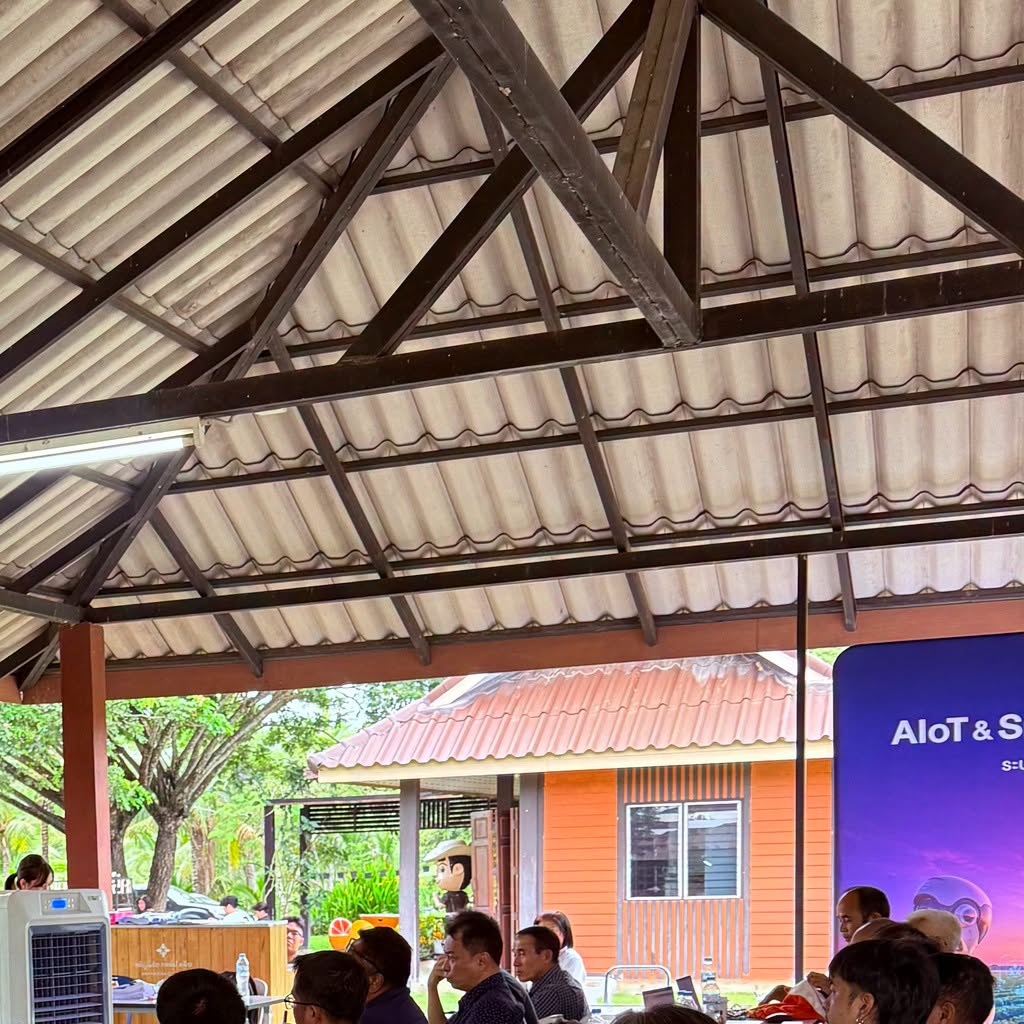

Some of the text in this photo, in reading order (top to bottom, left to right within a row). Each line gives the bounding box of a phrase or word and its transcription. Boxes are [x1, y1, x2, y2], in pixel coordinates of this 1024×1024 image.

[891, 713, 1024, 745] AIoT & S
